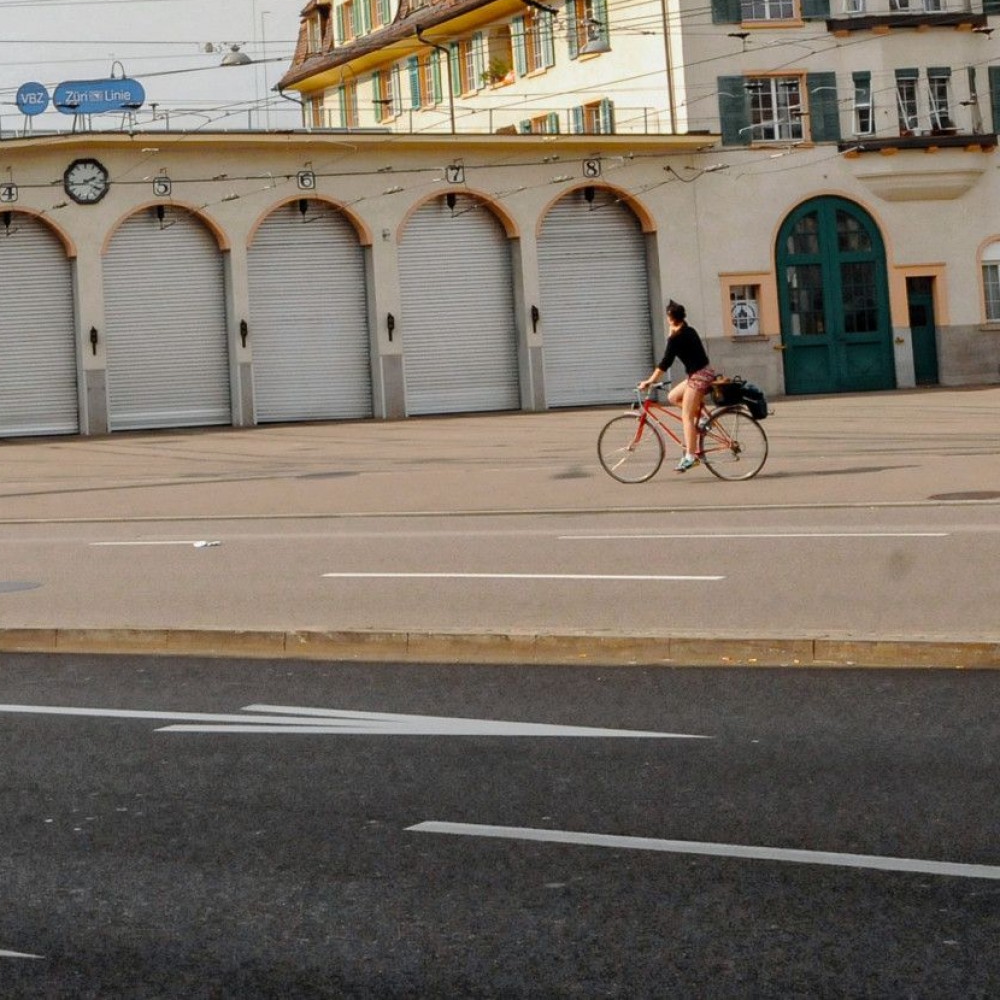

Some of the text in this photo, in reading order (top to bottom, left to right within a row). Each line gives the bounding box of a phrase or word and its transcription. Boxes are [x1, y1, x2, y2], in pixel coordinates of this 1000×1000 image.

[21, 93, 44, 104] VBZ
[65, 90, 131, 103] Züri Linie
[450, 166, 460, 181] 7
[586, 162, 597, 177] 8
[157, 179, 168, 194] 5
[300, 173, 311, 188] 6
[2, 186, 14, 200] 4
